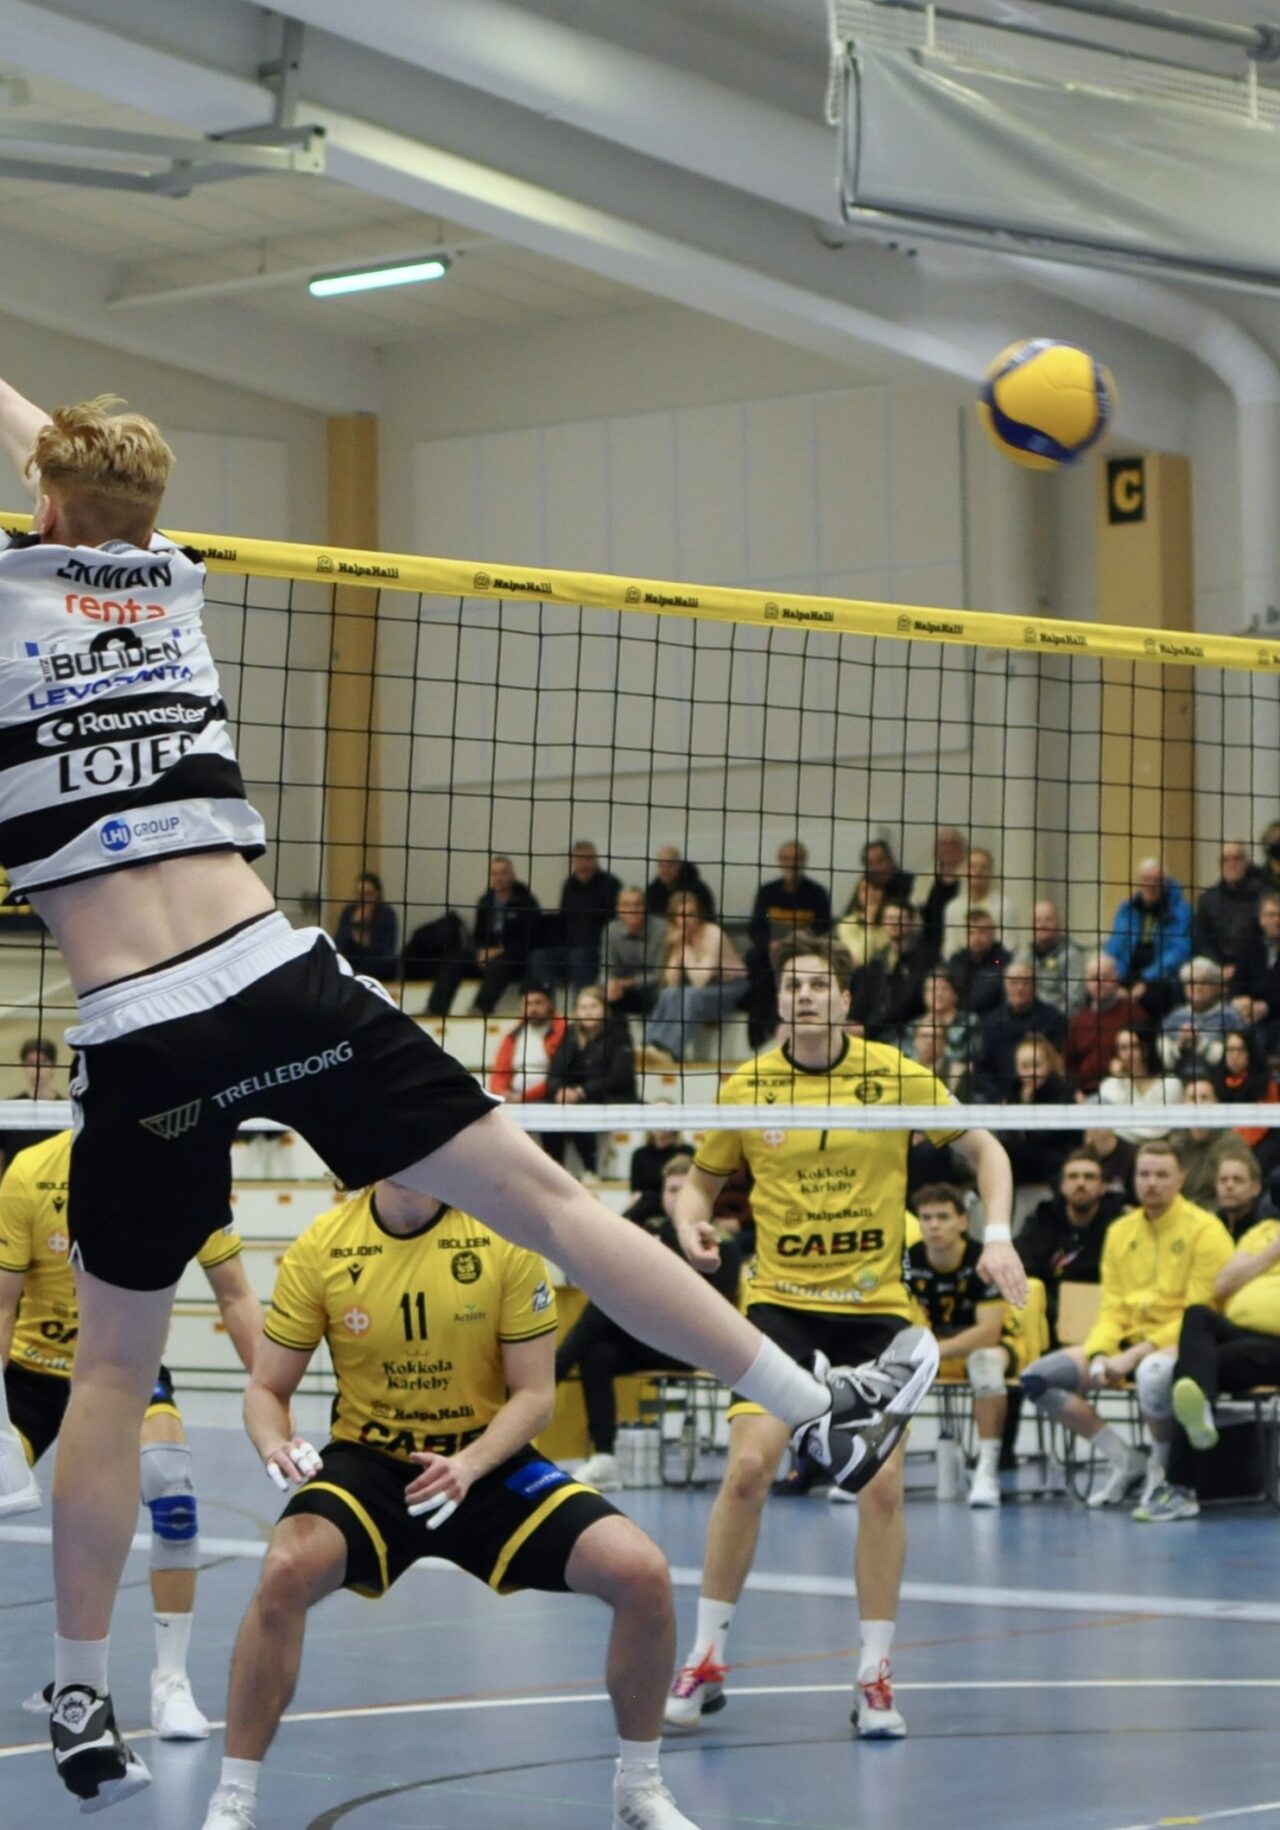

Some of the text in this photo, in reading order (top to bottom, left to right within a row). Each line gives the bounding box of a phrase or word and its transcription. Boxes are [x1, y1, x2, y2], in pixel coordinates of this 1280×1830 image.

[1113, 469, 1142, 513] C
[337, 562, 399, 579] HalpaHalli
[493, 578, 552, 593] HalpaHalli
[644, 593, 699, 608] HalpaHalli
[781, 608, 834, 622] HalpaHalli
[78, 703, 207, 736] Raumaster
[133, 817, 180, 837] GROUP
[211, 1040, 354, 1109] TRELLEBORG
[797, 1165, 857, 1181] Kokkola
[440, 1236, 491, 1249] BOLIDEN
[776, 1229, 885, 1258] CABB
[334, 1245, 383, 1258] BOLIDEN
[400, 1291, 428, 1341] 11
[383, 1358, 453, 1376] Kokkola
[387, 1376, 450, 1391] Karleby
[394, 1404, 475, 1422] HalpaHalli
